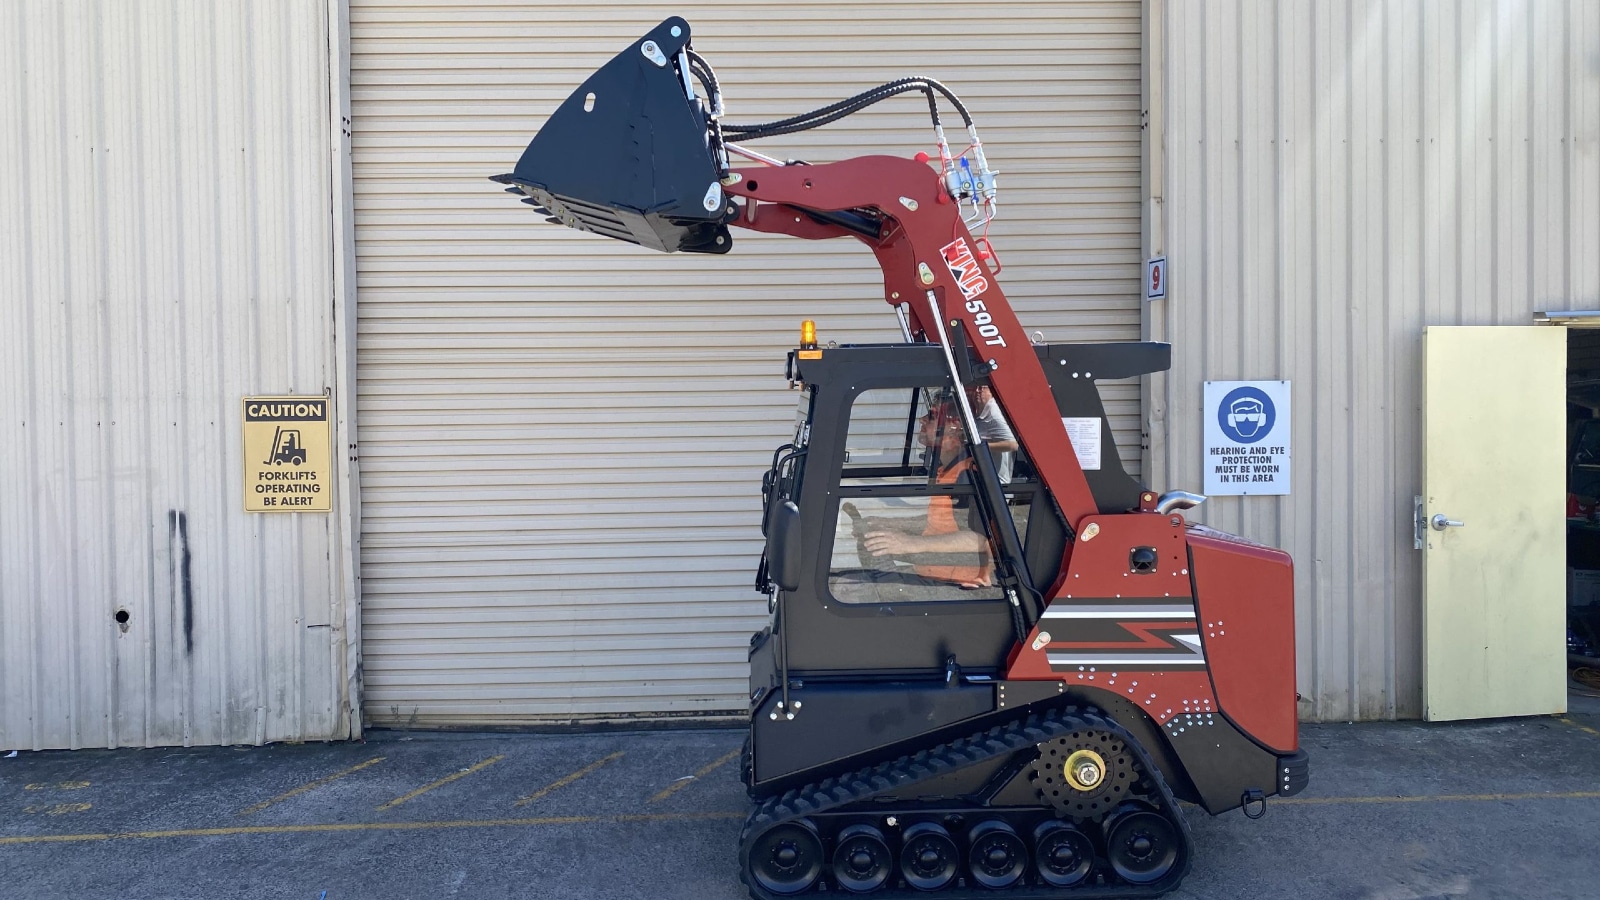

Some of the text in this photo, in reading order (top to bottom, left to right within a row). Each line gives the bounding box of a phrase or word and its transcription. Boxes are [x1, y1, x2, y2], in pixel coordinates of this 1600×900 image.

[1153, 265, 1160, 290] 9
[965, 300, 1007, 348] 590T
[248, 404, 321, 417] CAUTION
[1210, 446, 1285, 456] HEARING AND EYE
[1222, 456, 1272, 464] PROTECTION
[1215, 465, 1280, 474] MUST BE WORN
[258, 471, 317, 481] FORKLIFTS
[1220, 474, 1274, 483] IN THIS AREA
[255, 483, 321, 493] OPERATING
[263, 496, 314, 506] BE ALERT
